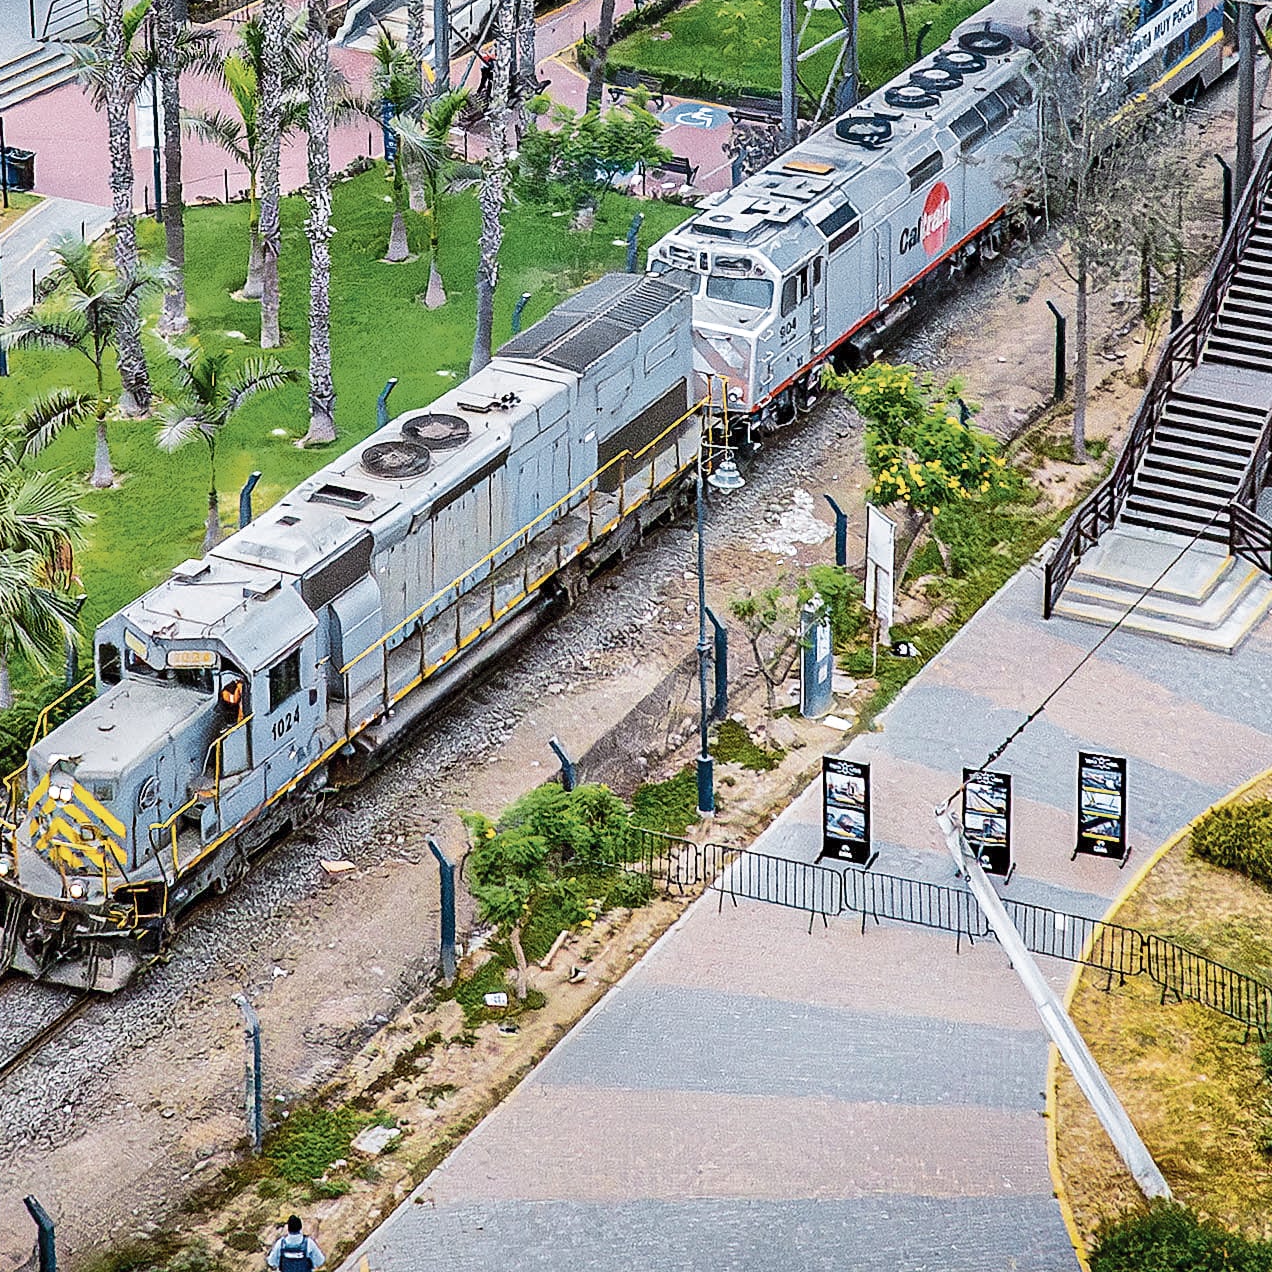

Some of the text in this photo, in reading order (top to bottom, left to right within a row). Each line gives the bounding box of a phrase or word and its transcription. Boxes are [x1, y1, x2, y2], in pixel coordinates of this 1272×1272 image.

[1153, 15, 1171, 41] MUY
[899, 198, 951, 255] Caltrain
[271, 703, 300, 741] 1024
